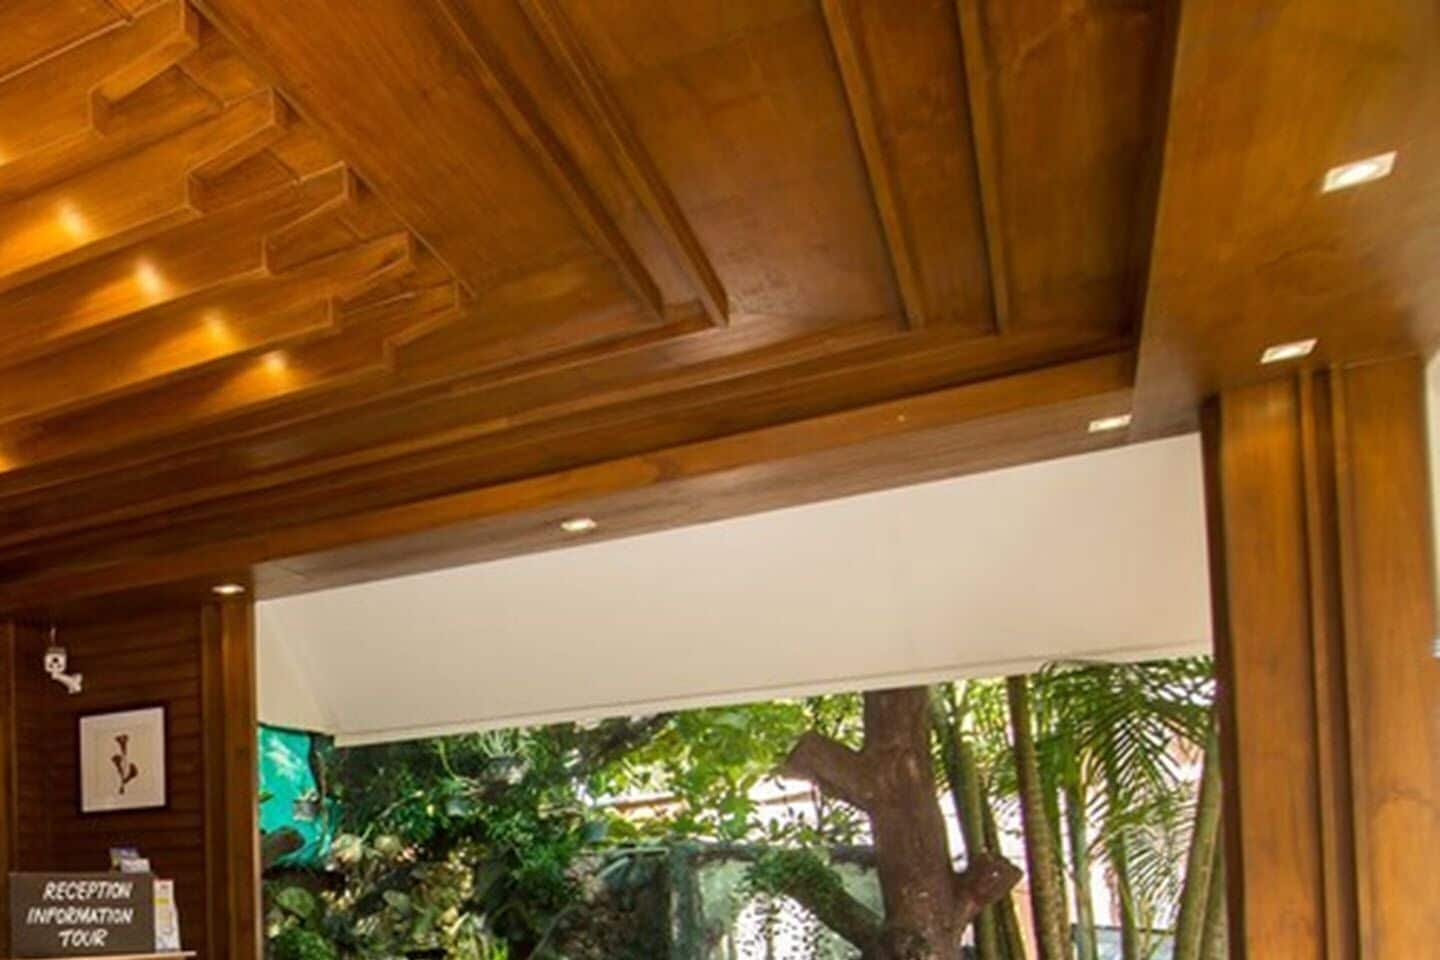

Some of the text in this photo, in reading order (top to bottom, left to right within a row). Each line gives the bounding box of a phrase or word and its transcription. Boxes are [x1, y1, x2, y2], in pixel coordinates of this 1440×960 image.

[43, 880, 134, 900] RECEPTION
[26, 905, 134, 925] INFORMATION
[58, 929, 109, 947] TOUR
